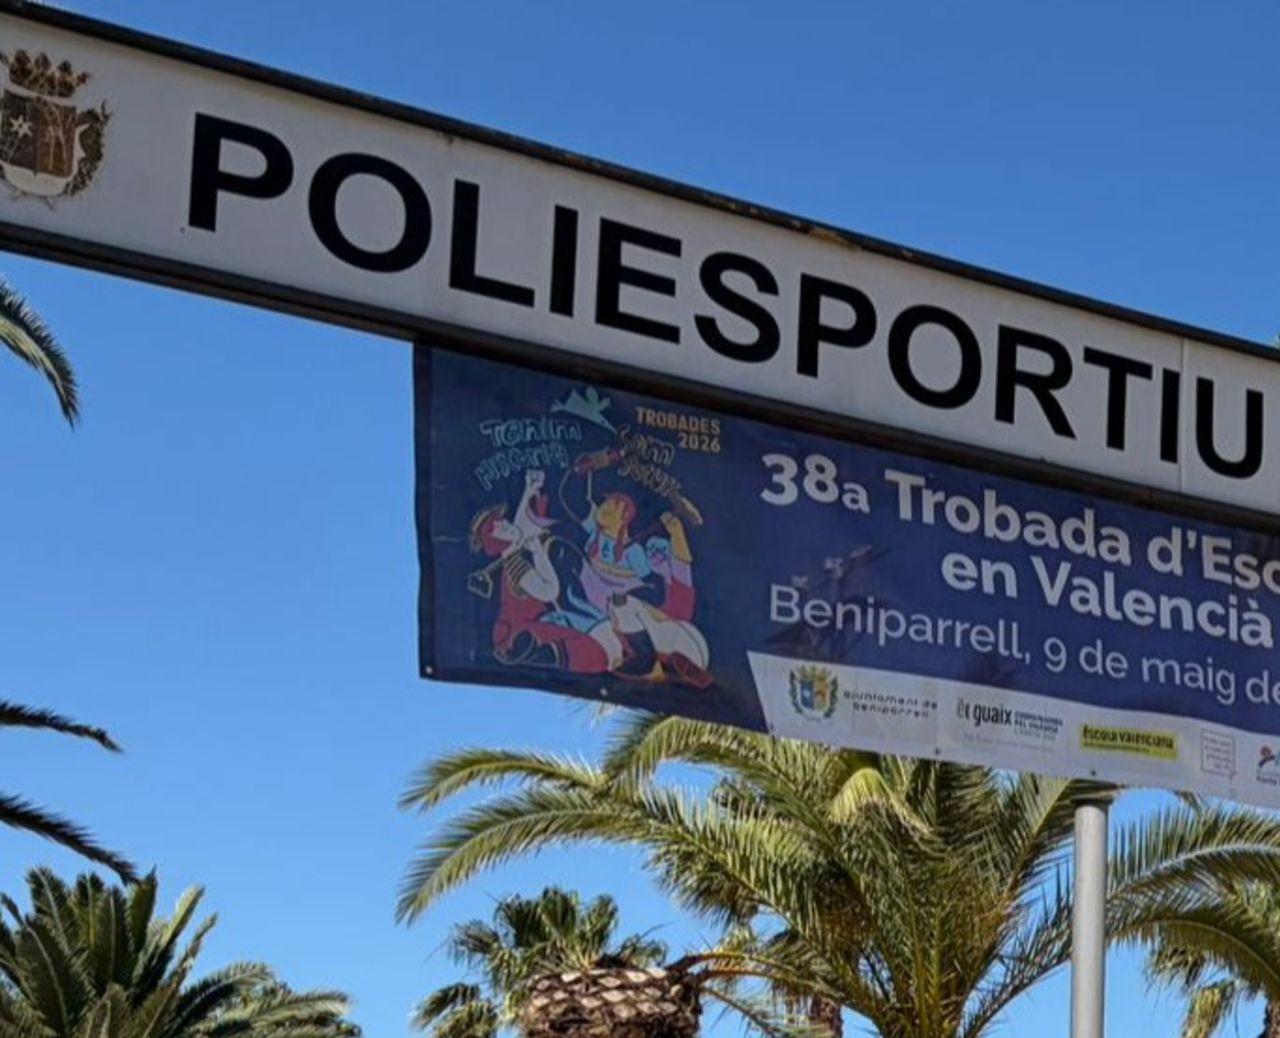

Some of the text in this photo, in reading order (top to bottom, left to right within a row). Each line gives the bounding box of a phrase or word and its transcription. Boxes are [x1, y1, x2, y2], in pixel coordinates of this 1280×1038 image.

[187, 112, 1265, 480] POLIESPORTIU
[634, 405, 721, 435] TROBADES
[677, 432, 721, 453] 2026
[884, 468, 1132, 566] Trobada
[769, 584, 1032, 664] Beniparrell,
[1042, 636, 1068, 673] 9
[1078, 637, 1129, 679] de
[1141, 655, 1239, 704] maig
[940, 553, 1275, 649] en Valencià
